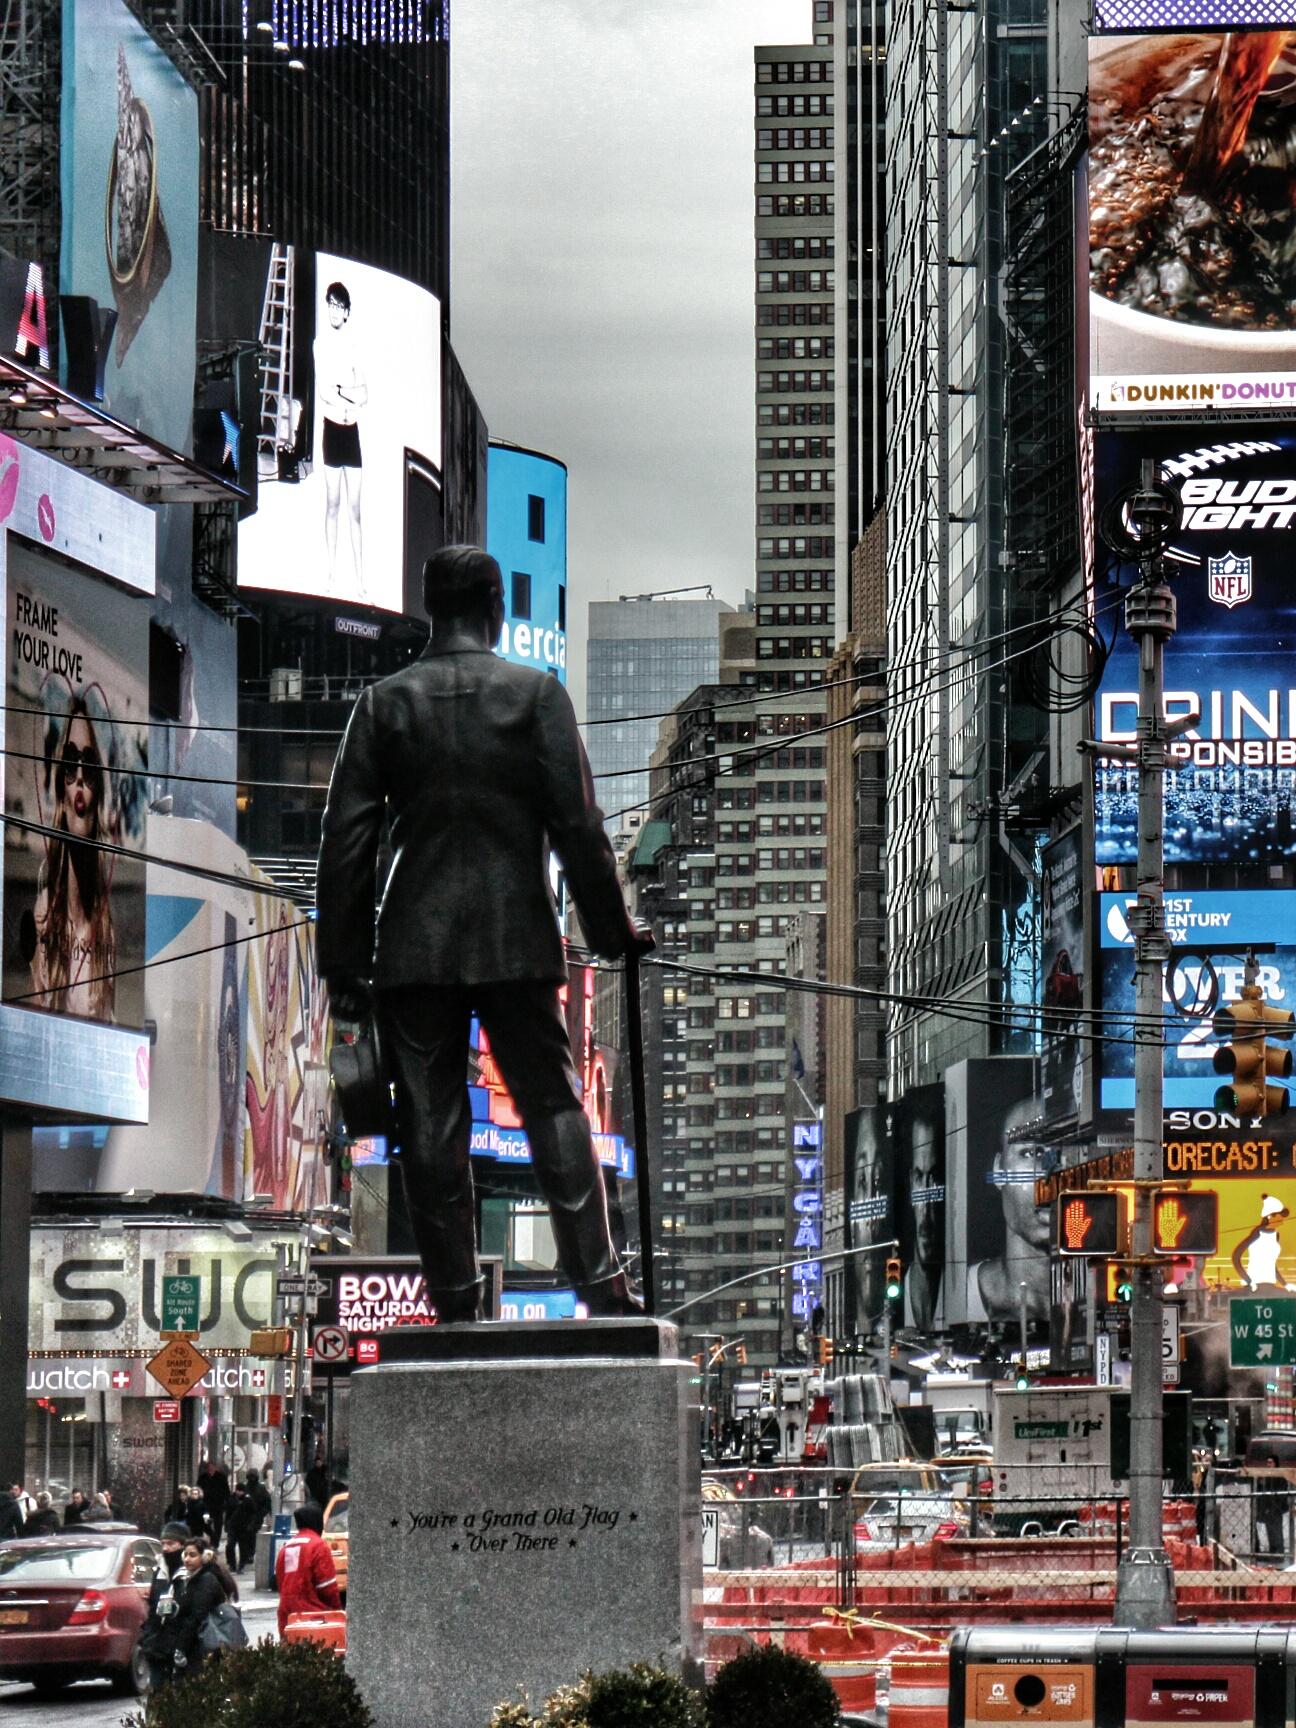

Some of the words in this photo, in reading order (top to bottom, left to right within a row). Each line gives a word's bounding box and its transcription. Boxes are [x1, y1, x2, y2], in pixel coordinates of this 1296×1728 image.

[1128, 383, 1221, 402] DUNKIN'
[1214, 575, 1247, 600] NFL
[16, 592, 59, 637] FRAME
[336, 617, 380, 639] OUTFRONT
[16, 630, 50, 671] YOUR
[52, 643, 83, 684] LOVE
[1164, 912, 1232, 928] ENTURY
[1165, 929, 1187, 943] OX
[1163, 1142, 1279, 1171] ORECAST:
[168, 1306, 194, 1316] South
[338, 1300, 437, 1317] SATURDA
[1255, 1305, 1273, 1320] To
[1234, 1326, 1249, 1338] W
[1254, 1325, 1273, 1338] 45
[1278, 1324, 1294, 1338] St
[166, 1359, 193, 1368] SHARED
[1098, 1337, 1108, 1385] NYPD
[168, 1376, 191, 1386] AHEAD
[170, 1368, 187, 1377] ZONE
[193, 1364, 252, 1389] atch
[408, 1510, 457, 1534] You're
[463, 1513, 475, 1527] a
[482, 1509, 537, 1532] Grand
[543, 1508, 575, 1527] Old
[580, 1504, 621, 1531] Flag
[466, 1532, 510, 1553] Over
[511, 1531, 560, 1552] There
[1205, 1692, 1229, 1703] PAPER
